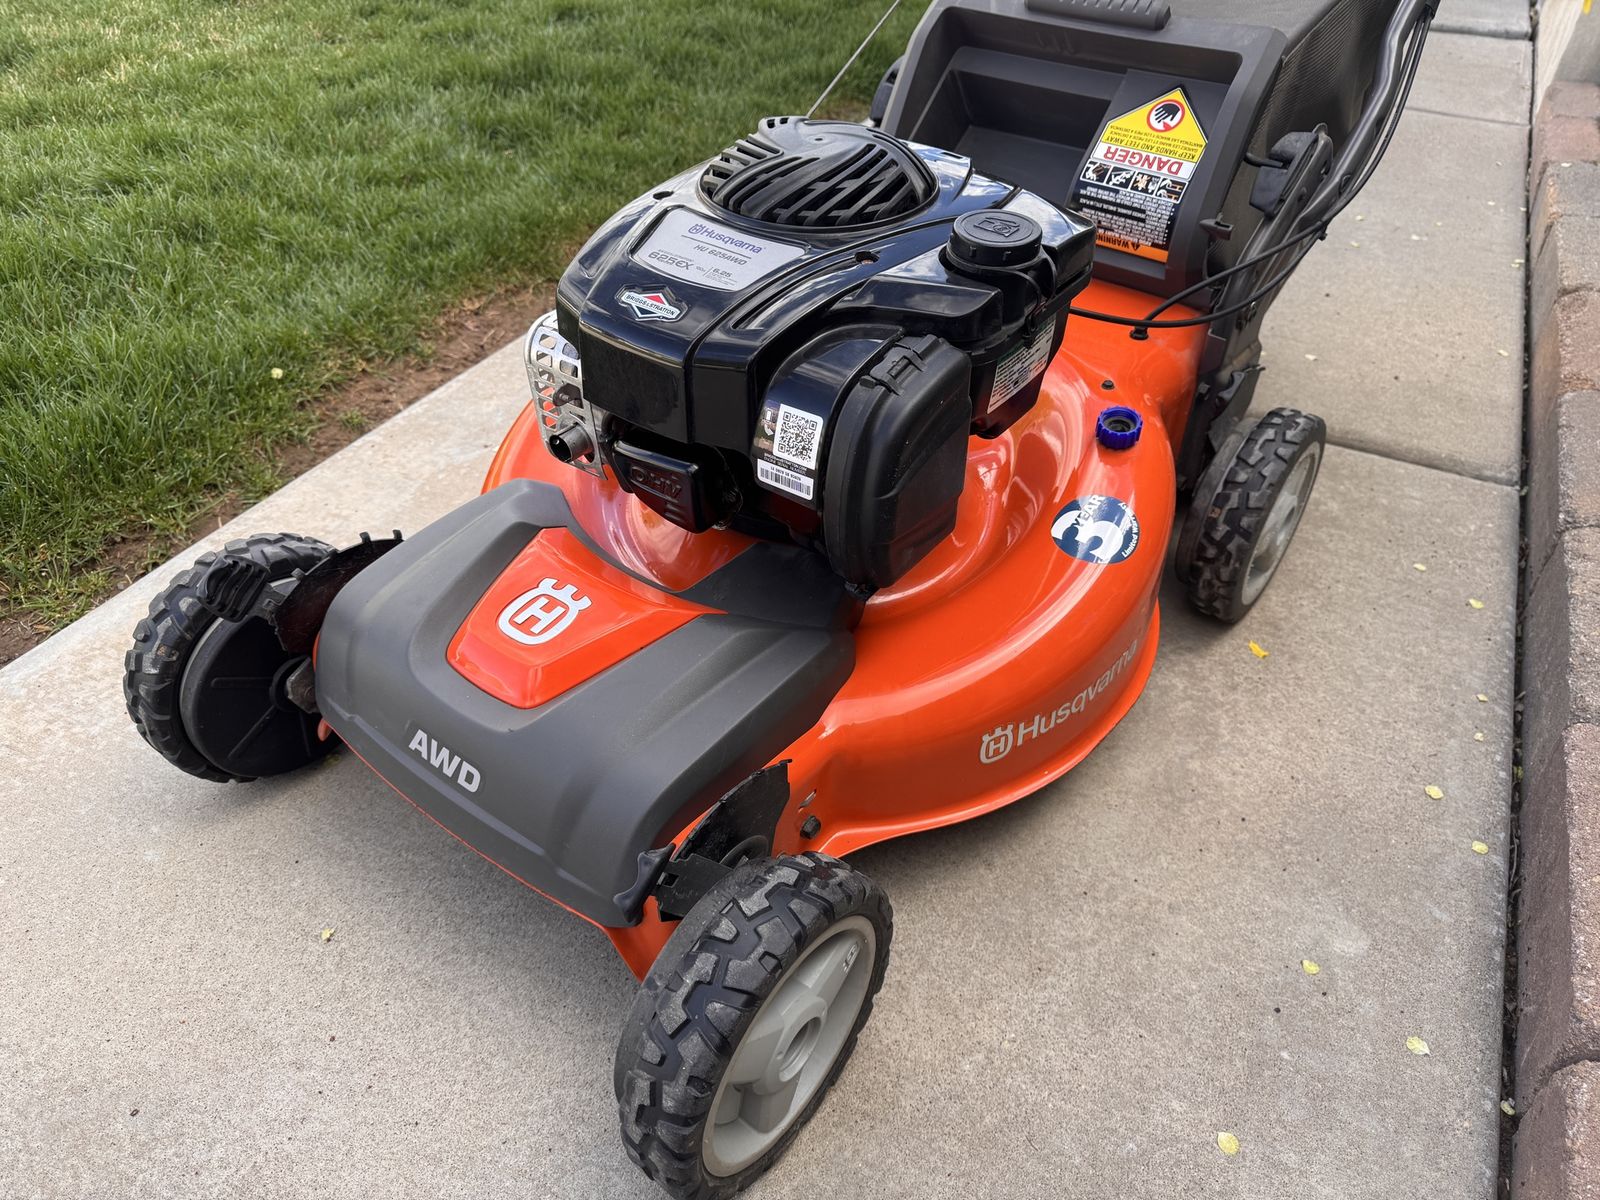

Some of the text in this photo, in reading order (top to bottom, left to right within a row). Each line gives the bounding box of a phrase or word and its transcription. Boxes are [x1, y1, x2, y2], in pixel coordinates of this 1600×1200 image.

[1105, 136, 1124, 144] AWAY
[1124, 140, 1140, 148] FEET
[1155, 147, 1178, 156] HANDS
[1103, 146, 1183, 175] DANGER
[1178, 152, 1195, 160] KEEP
[701, 226, 762, 253] Husqvarna
[1096, 235, 1130, 248] WARNIN
[694, 244, 707, 252] HU
[708, 249, 747, 266] 625AWD
[1071, 495, 1106, 526] YEAR
[1050, 509, 1125, 564] 3
[1121, 533, 1138, 558] Limited
[1017, 640, 1137, 747] Husqvarna
[408, 729, 481, 793] AWD
